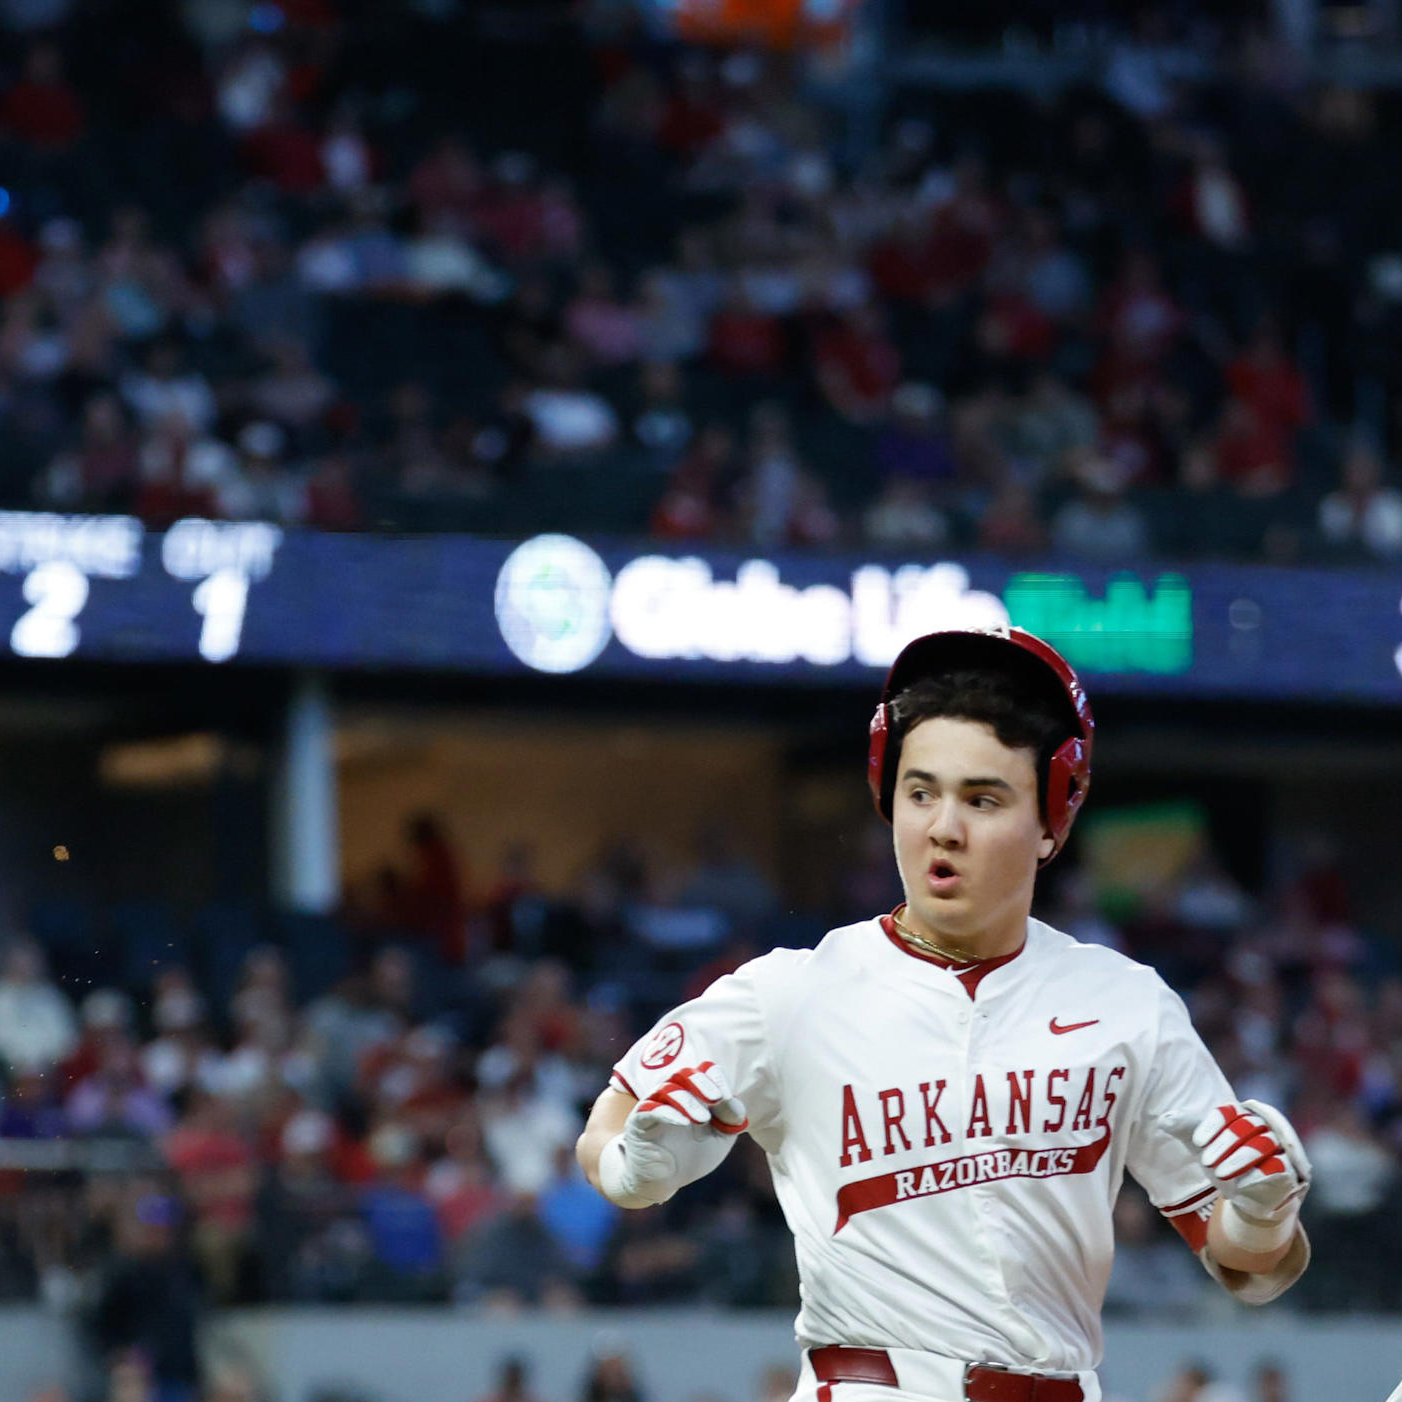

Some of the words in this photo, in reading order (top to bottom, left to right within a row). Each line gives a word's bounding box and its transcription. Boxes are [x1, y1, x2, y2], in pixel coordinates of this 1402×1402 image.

[10, 560, 89, 658] 2
[192, 567, 249, 663] 1
[839, 1067, 1125, 1167] ARKANSAS
[895, 1149, 1077, 1199] RAZORBACKS
